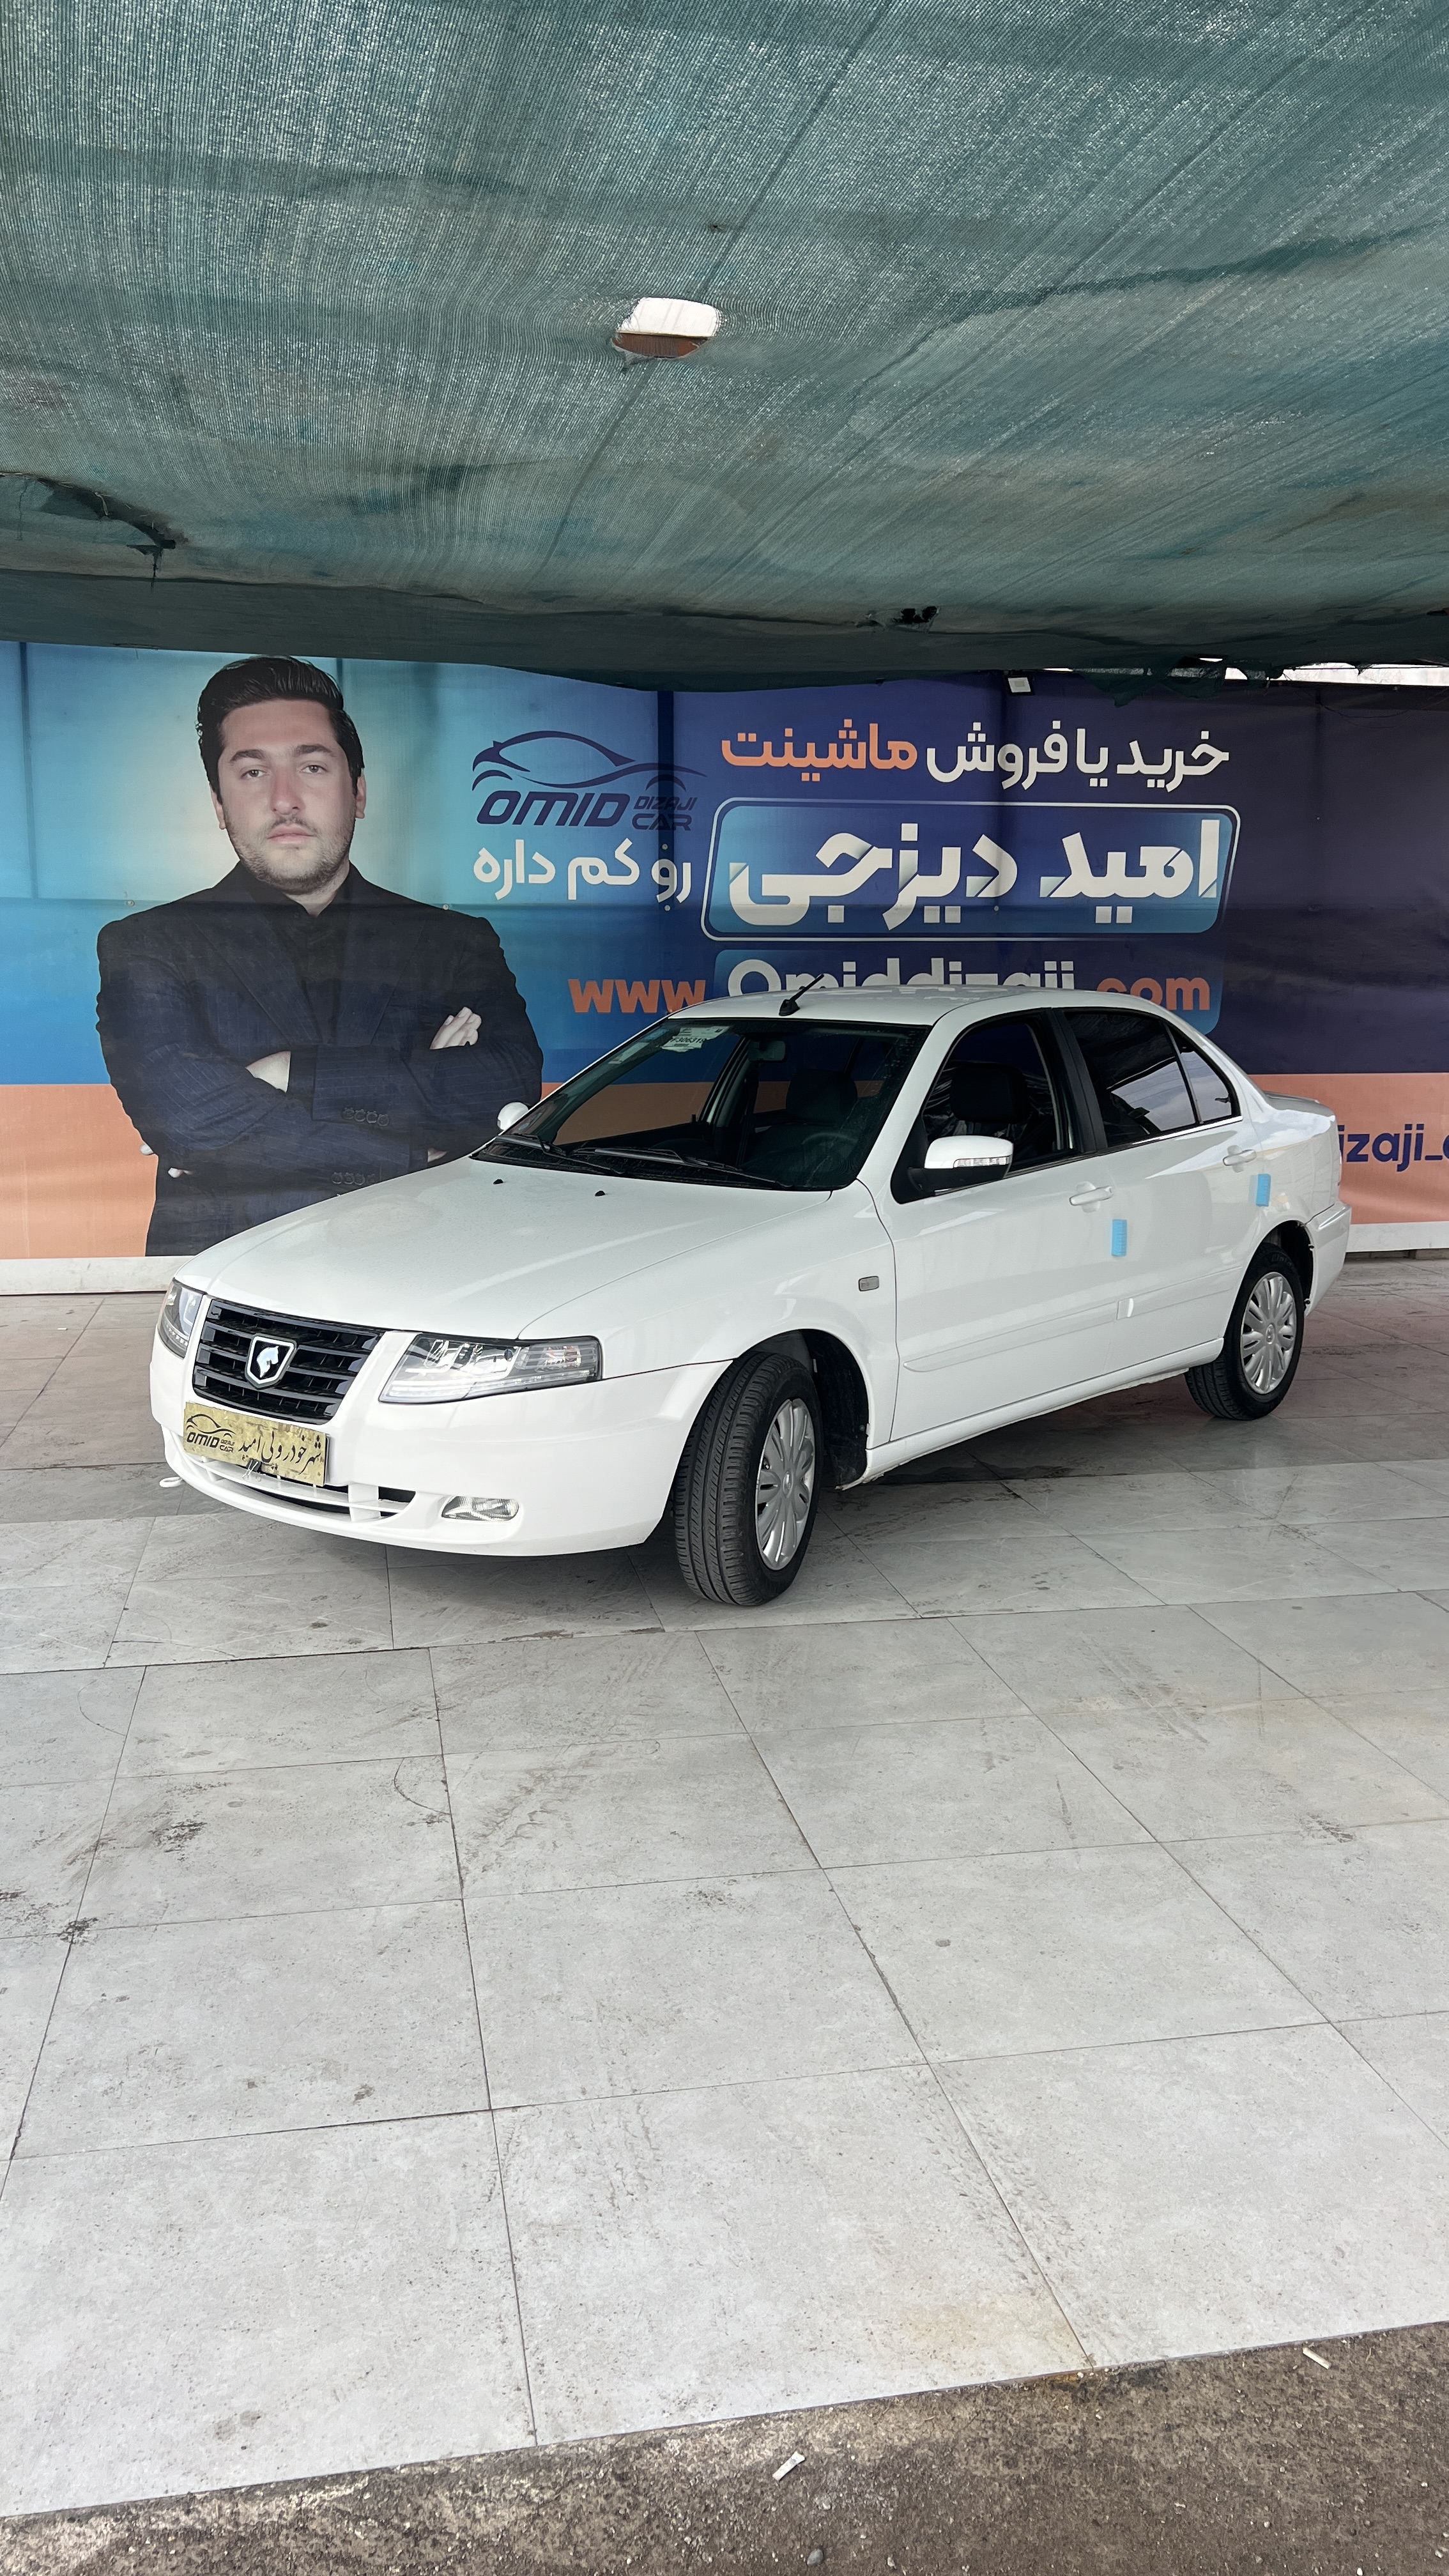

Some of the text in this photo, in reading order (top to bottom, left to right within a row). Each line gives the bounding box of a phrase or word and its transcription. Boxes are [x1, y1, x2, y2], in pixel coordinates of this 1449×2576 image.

[721, 719, 1230, 793] خرید یا فروش ماشینت
[477, 791, 631, 827] OMID
[633, 796, 698, 811] DIZAJI
[632, 813, 692, 831] CAR
[471, 838, 691, 903] رو کم داره
[729, 819, 1220, 931] امید دیزجی
[187, 1431, 220, 1448] OMID
[219, 1445, 234, 1453] CAR
[238, 1436, 261, 1461] امید
[298, 1434, 322, 1475] شهر
